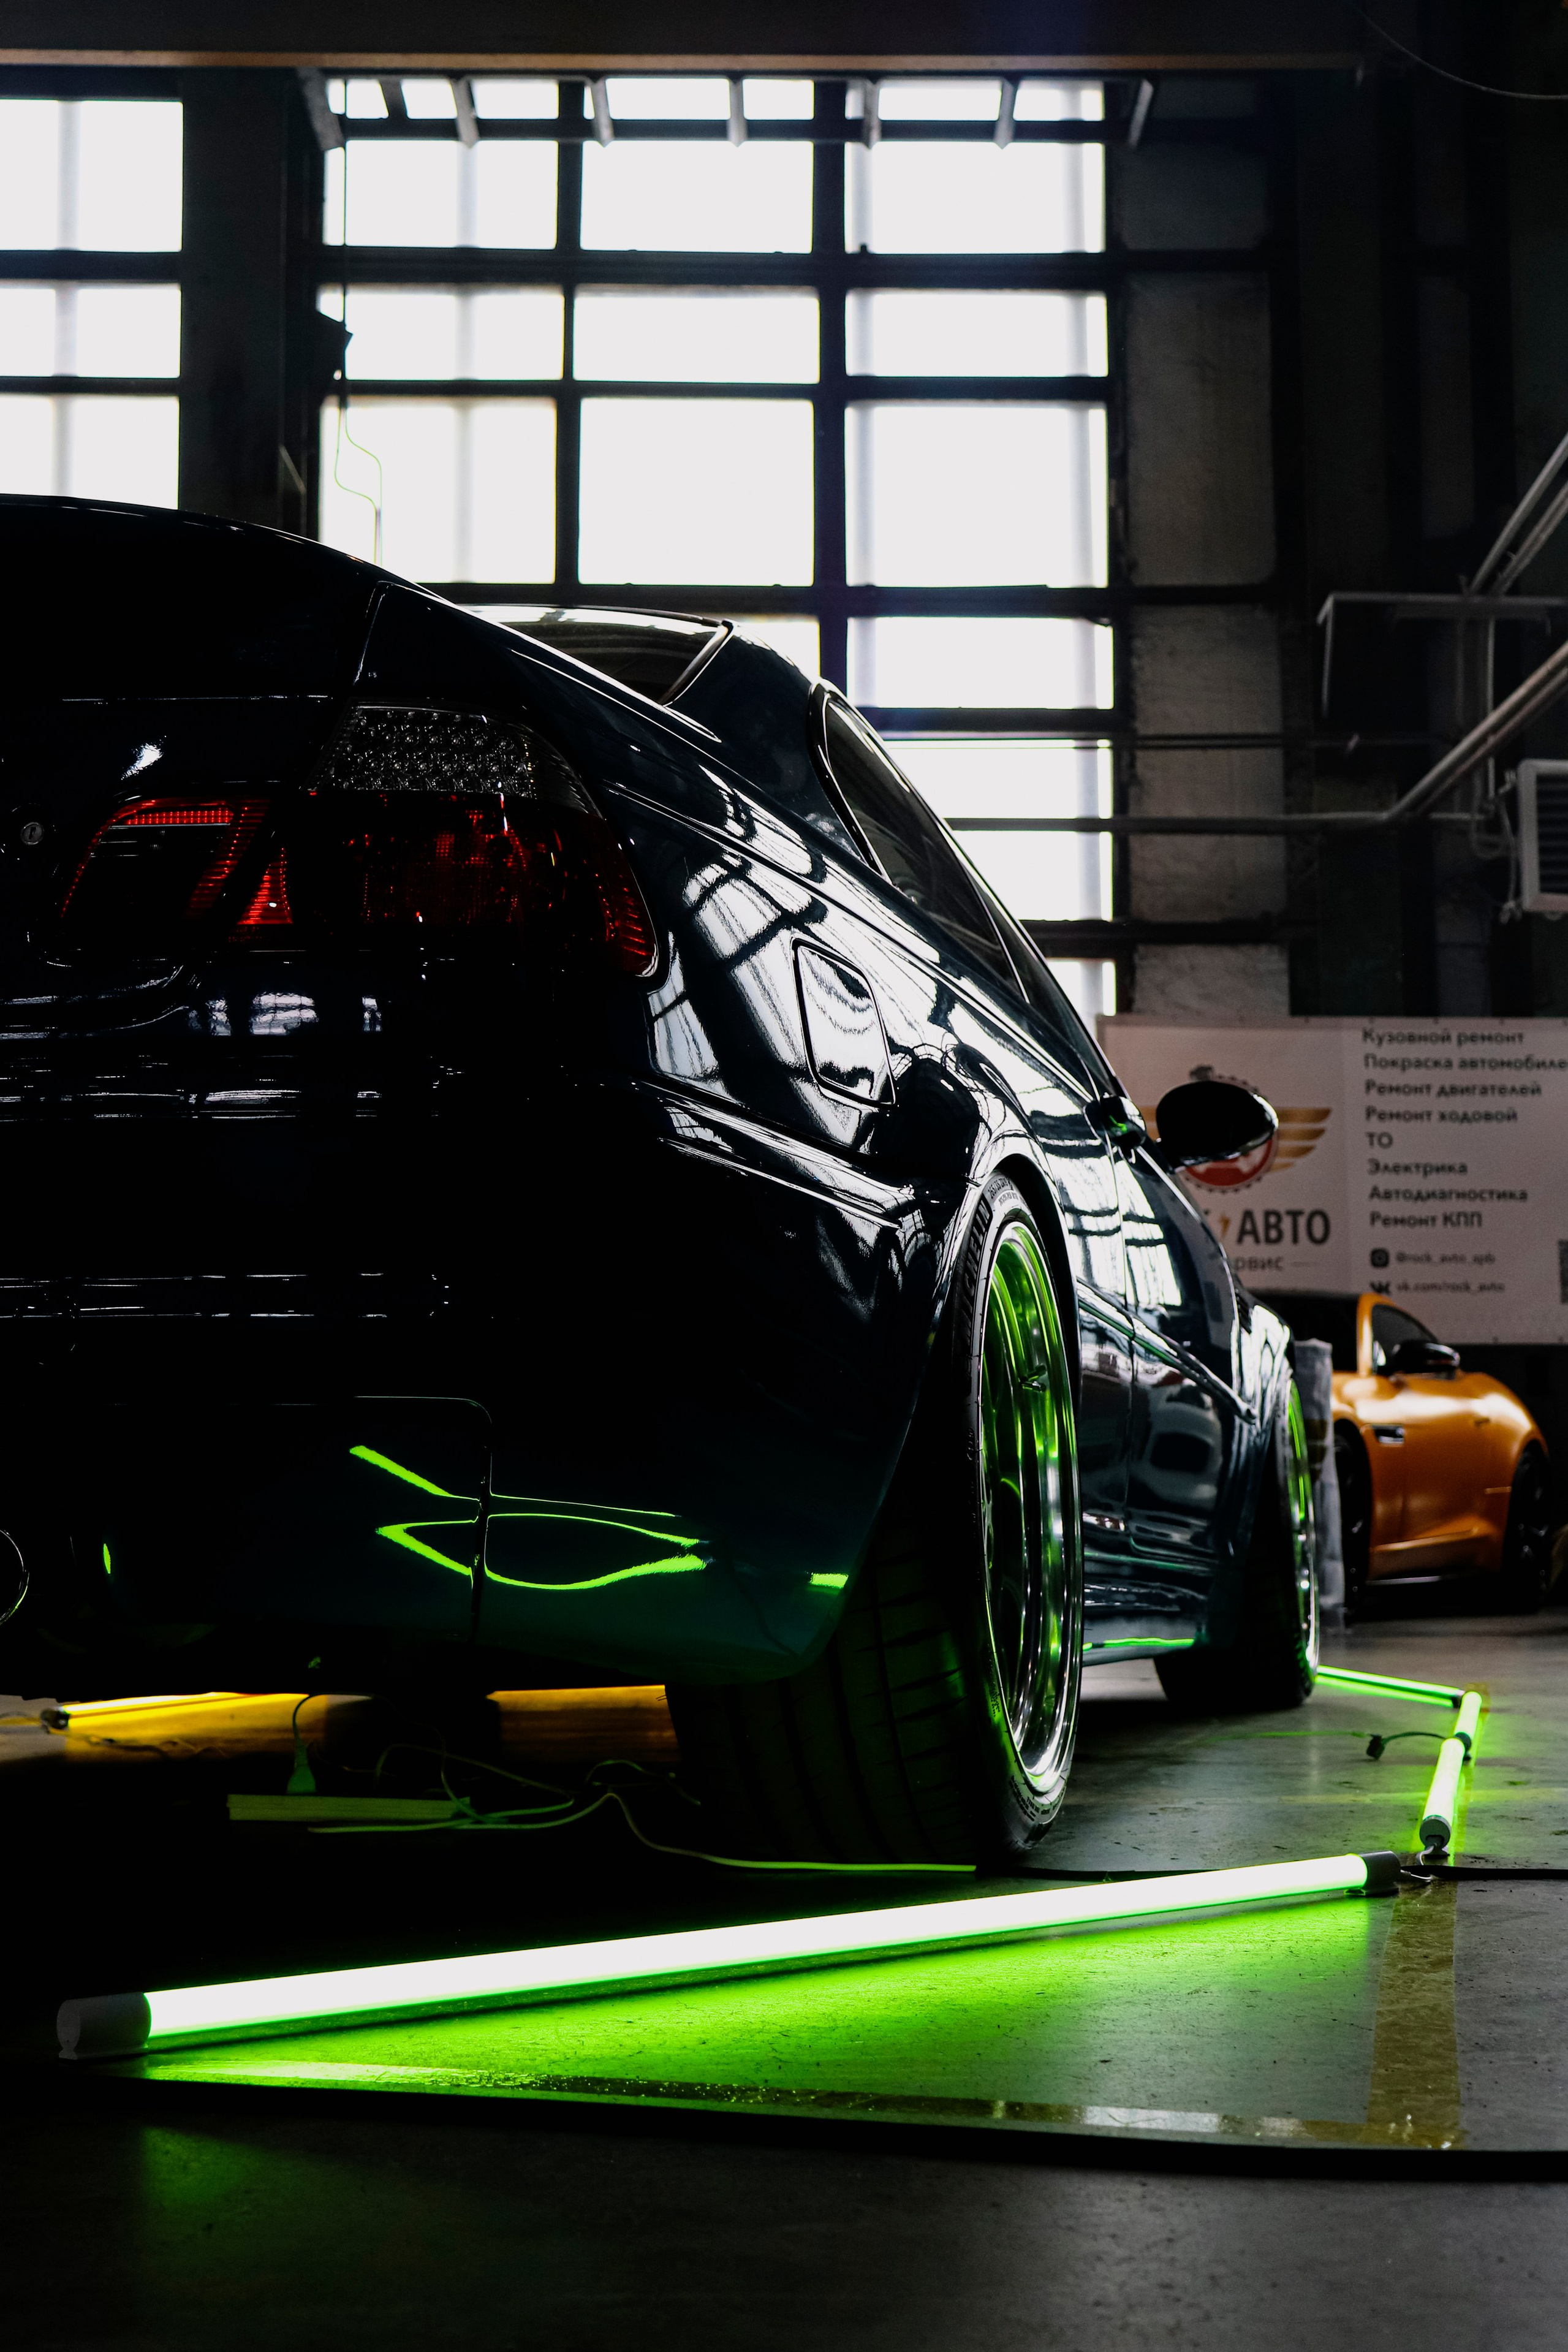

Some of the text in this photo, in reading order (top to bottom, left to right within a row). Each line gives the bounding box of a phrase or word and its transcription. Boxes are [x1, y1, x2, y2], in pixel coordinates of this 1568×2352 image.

[1362, 1026, 1523, 1049] Кузовной ремонт
[1364, 1053, 1568, 1073] Покраска автомобиле
[1365, 1079, 1542, 1098] Ремонт двигателей
[1365, 1106, 1518, 1124] Ремонт ходовой
[1366, 1131, 1393, 1149] ТО
[1367, 1158, 1468, 1178] Электрика
[1369, 1185, 1528, 1202] Автодиагностика
[1237, 1209, 1331, 1245] АВТО
[1369, 1211, 1483, 1227] Ремонт КПП
[960, 1199, 990, 1346] MICHELIN
